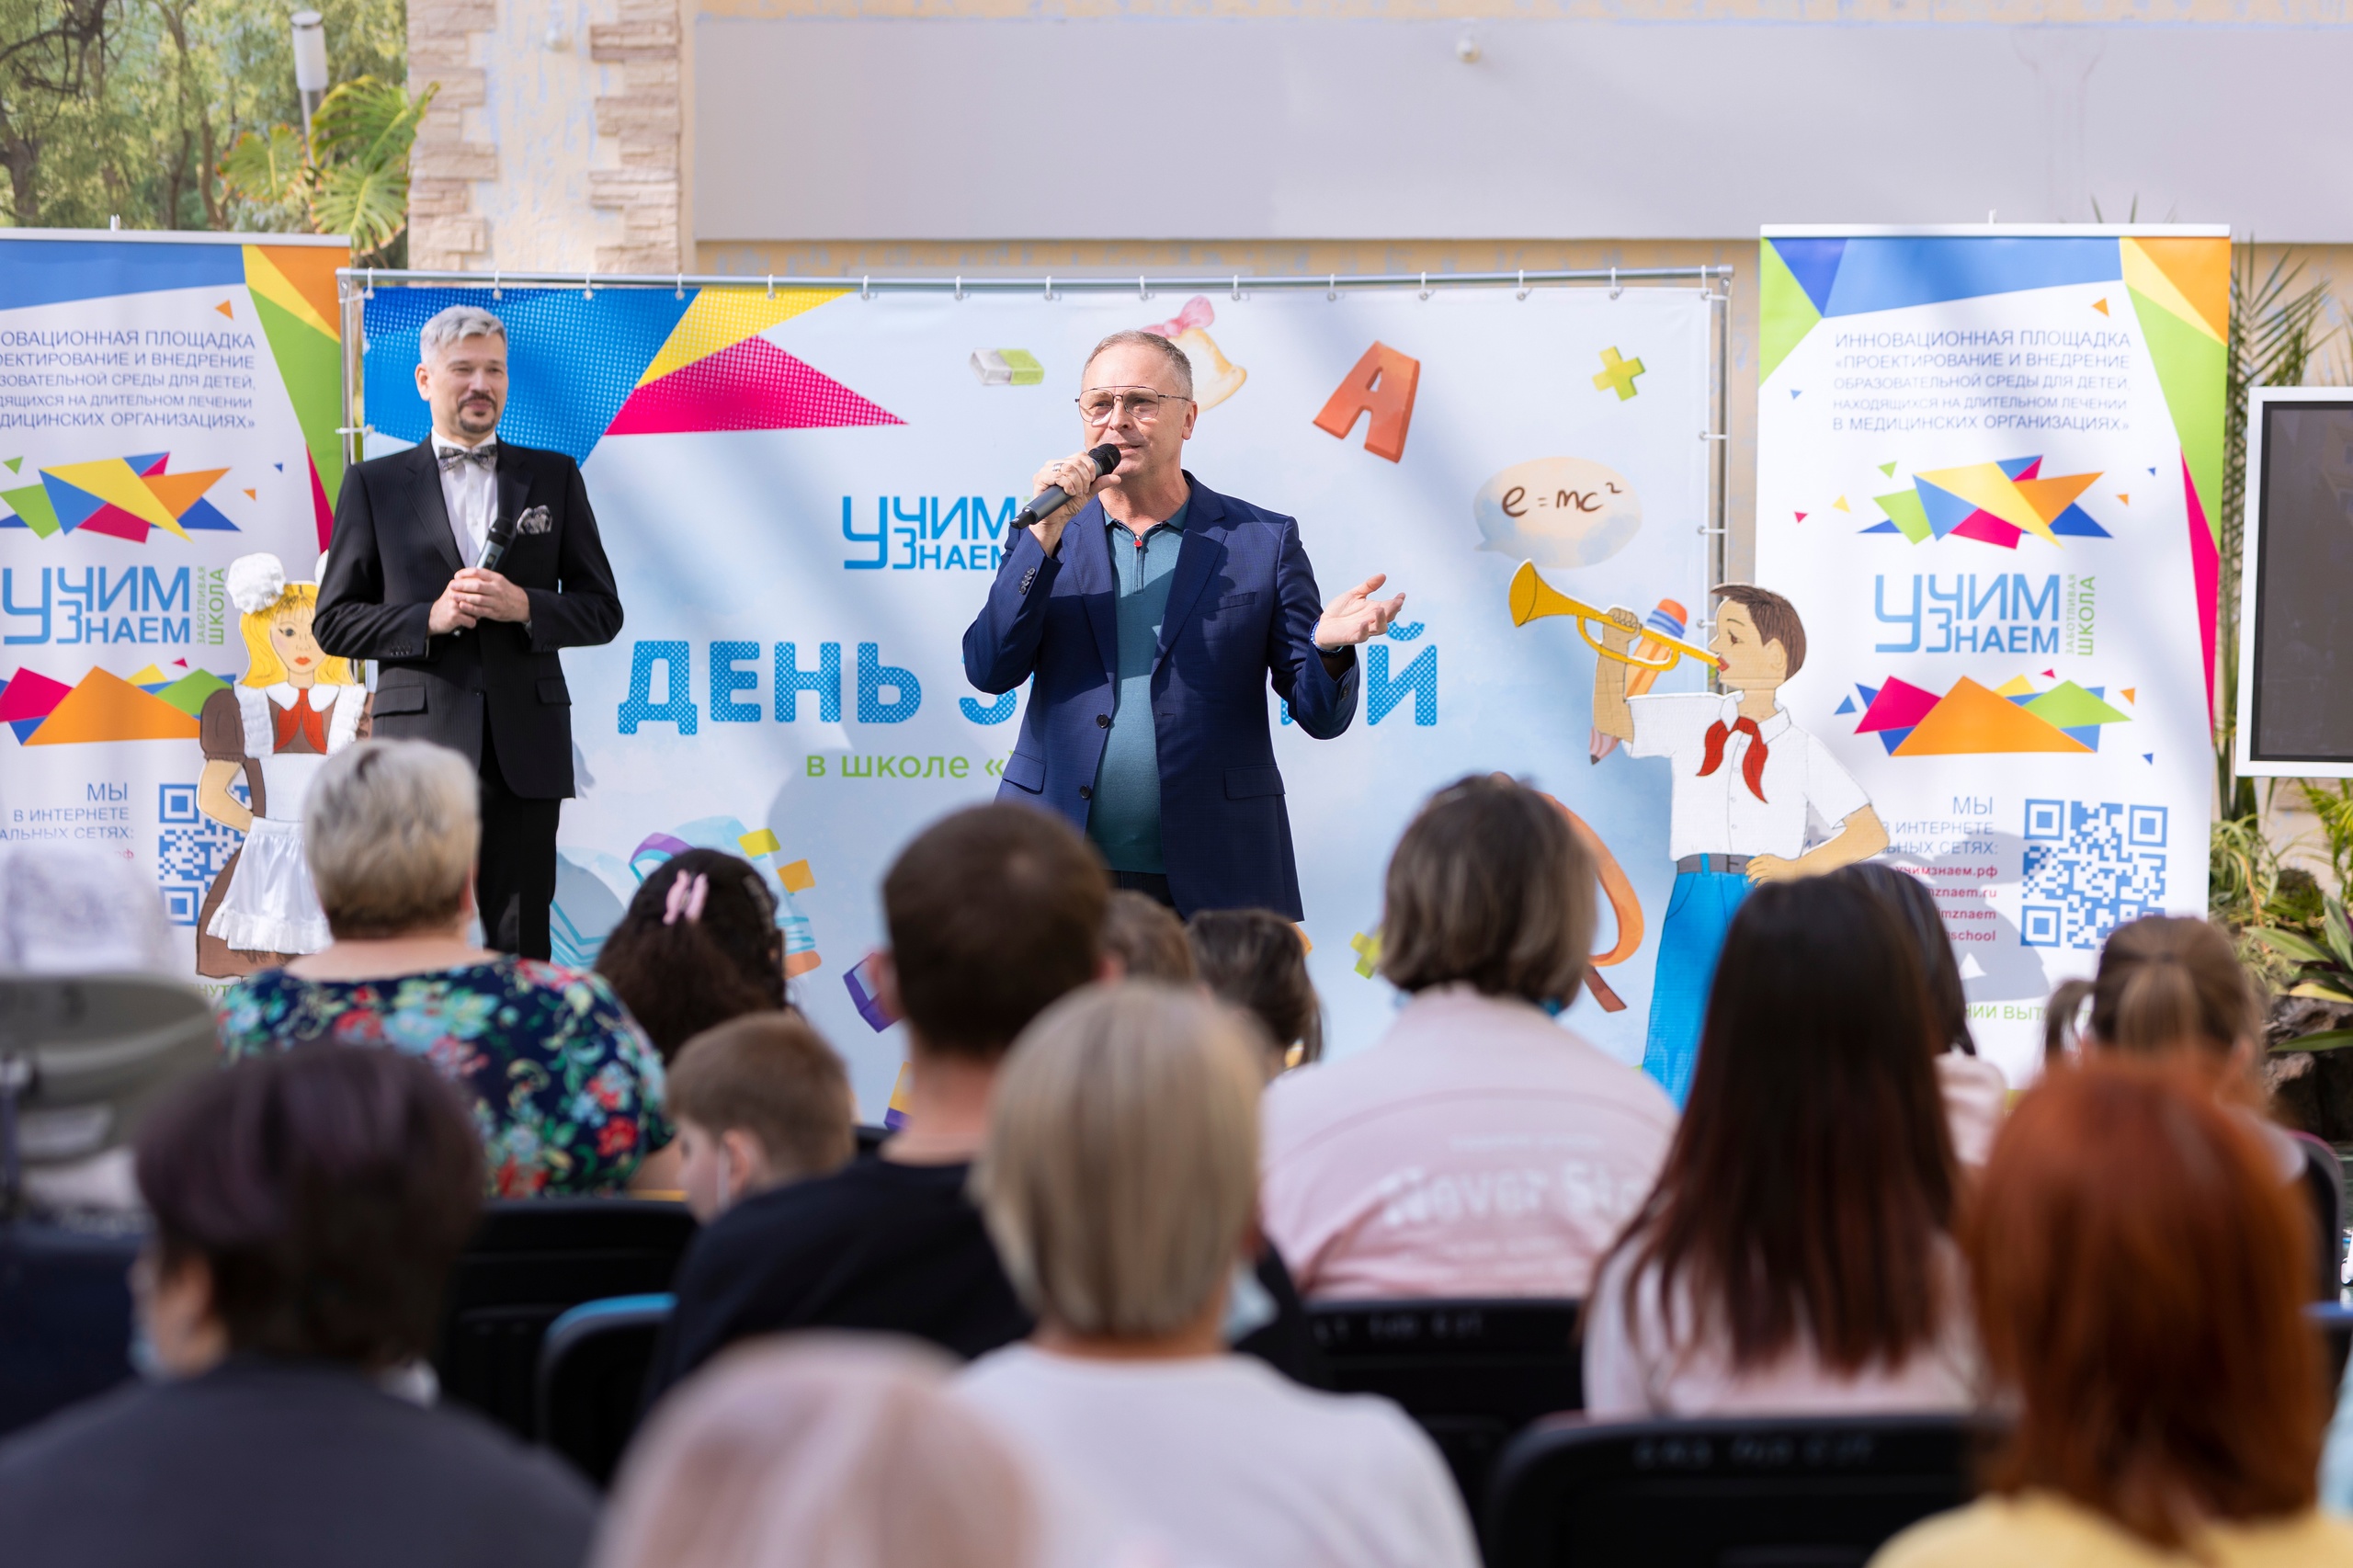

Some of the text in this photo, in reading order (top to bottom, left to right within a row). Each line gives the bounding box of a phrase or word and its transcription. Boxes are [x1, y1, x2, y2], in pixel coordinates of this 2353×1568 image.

[146, 331, 256, 350] ПЛОЩАДКА
[1836, 331, 2131, 350] ИННОВАЦИОННАЯ ПЛОЩАДКА
[0, 352, 255, 369] ЕКТИРОВАНИЕ И ВНЕДРЕНИЕ
[1836, 353, 2130, 369] «ПРОЕКТИРОВАНИЕ И ВНЕДРЕНИЕ
[112, 373, 165, 387] СРЕДЫ
[168, 374, 199, 388] ДЛЯ
[202, 375, 256, 391] ДЕТЕЙ,
[1834, 372, 1981, 390] ОБРАЗОВАТЕЛЬНОЙ
[1985, 375, 2039, 389] СРЕДЫ
[2042, 375, 2073, 389] ДЛЯ
[68, 395, 86, 406] НА
[89, 394, 184, 407] ДЛИТЕЛЬНОМ
[188, 395, 252, 408] ЛЕЧЕНИИ
[1834, 396, 2127, 411] НАХОДЯЩИХСЯ НА ДЛИТЕЛЬНОМ ЛЕЧЕНИИ
[111, 412, 256, 430] ОРГАНИЗАЦИЯХ»
[1833, 415, 2130, 433] В МЕДИЦИНСКИХ ОРГАНИЗАЦИЯХ»
[197, 566, 207, 644] ЗАБОТЛИВАЯ
[209, 568, 225, 645] ШКОЛА
[2066, 574, 2076, 654] ЗАБОТЛИВАЯ
[56, 600, 190, 644] ЗНАЕМ
[2077, 575, 2096, 656] ШКОЛА
[1926, 608, 2060, 653] ЗНАЕМ
[618, 641, 921, 735] ДЕНЬ
[841, 753, 969, 778] школе
[87, 782, 127, 801] МЫ
[1953, 796, 1993, 814] МЫ
[14, 807, 130, 823] В ИНТЕРНЕТЕ
[74, 826, 134, 839] СЕТЯХ:
[1896, 821, 1995, 835] ИНТЕРНЕТЕ
[1939, 841, 1998, 855] СЕТЯХ:
